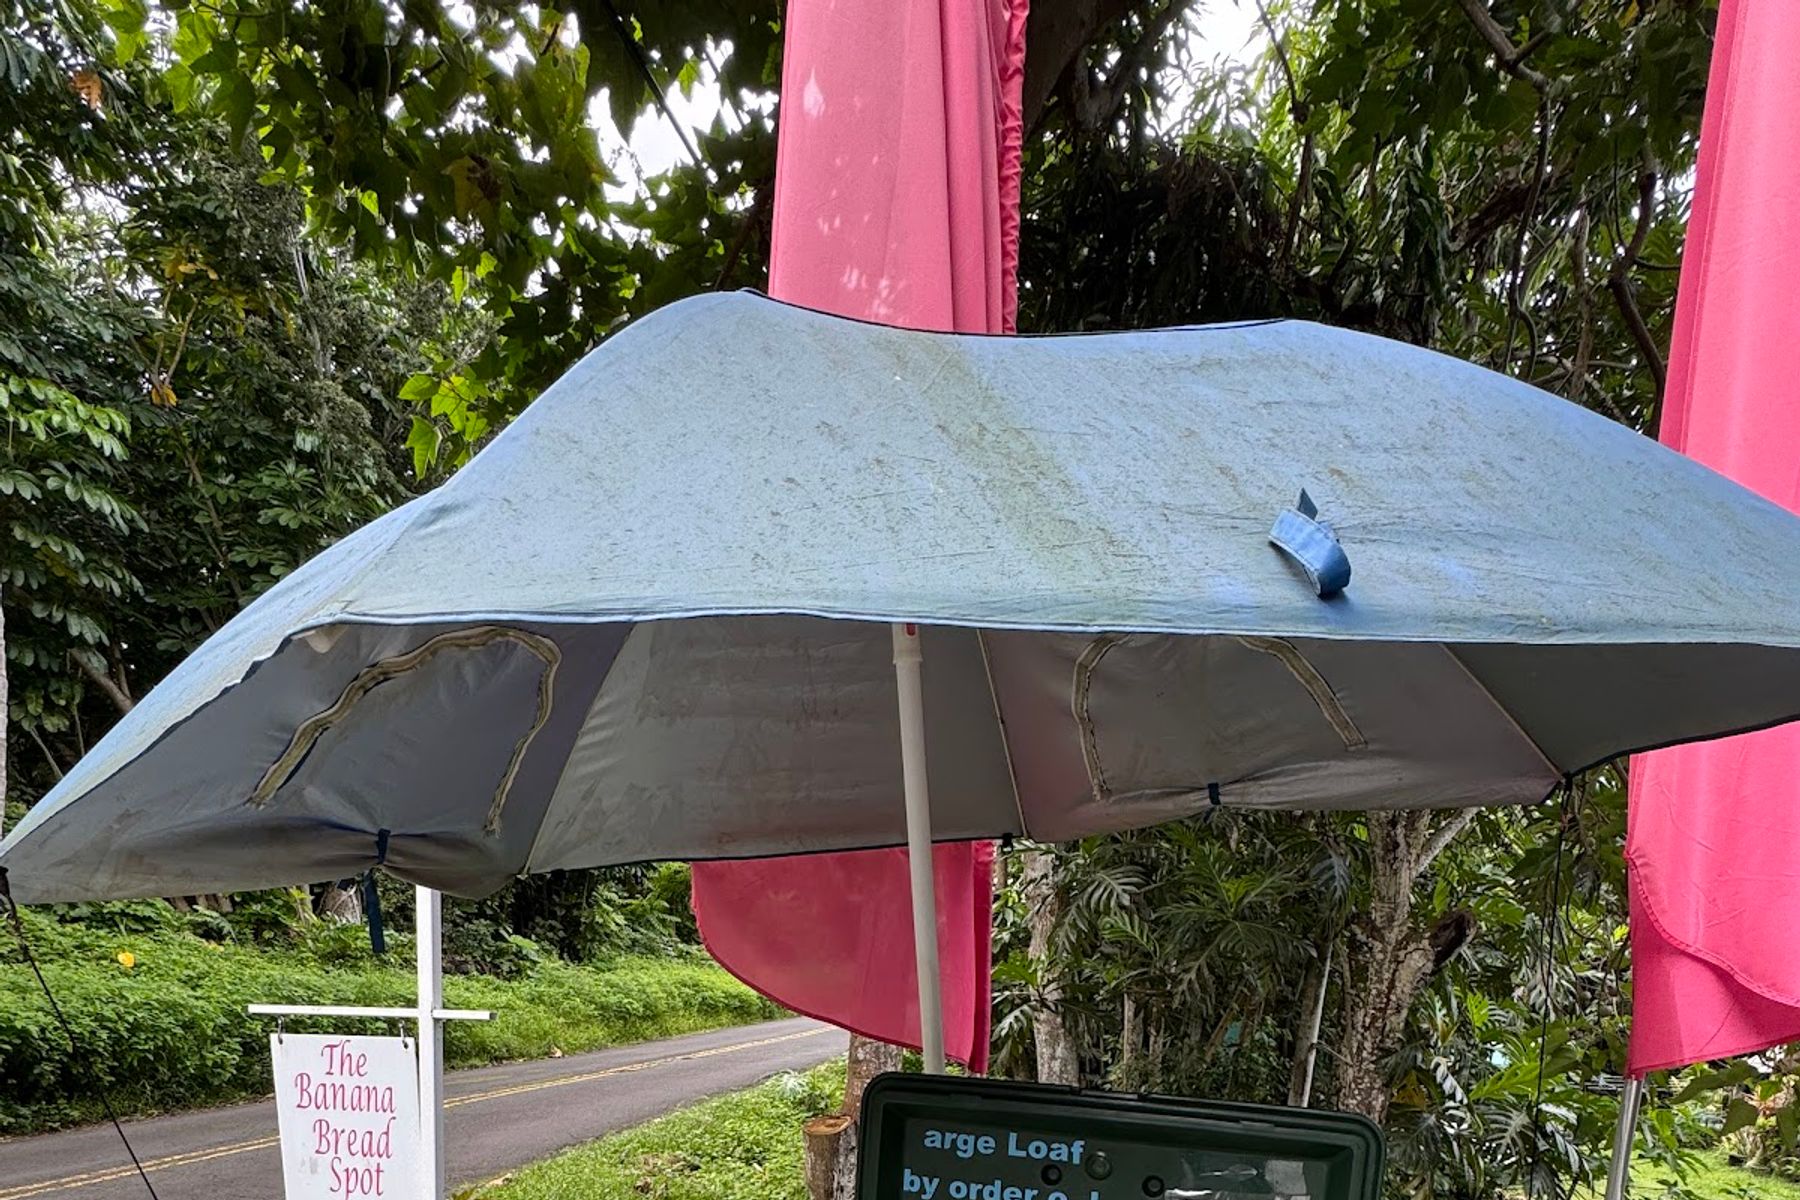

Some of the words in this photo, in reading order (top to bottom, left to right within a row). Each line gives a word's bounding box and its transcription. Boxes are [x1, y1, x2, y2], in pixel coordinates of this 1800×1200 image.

[321, 1040, 368, 1077] The
[294, 1072, 396, 1114] Banana
[313, 1117, 396, 1159] Bread
[1008, 1132, 1085, 1165] Loaf
[903, 1168, 940, 1200] by
